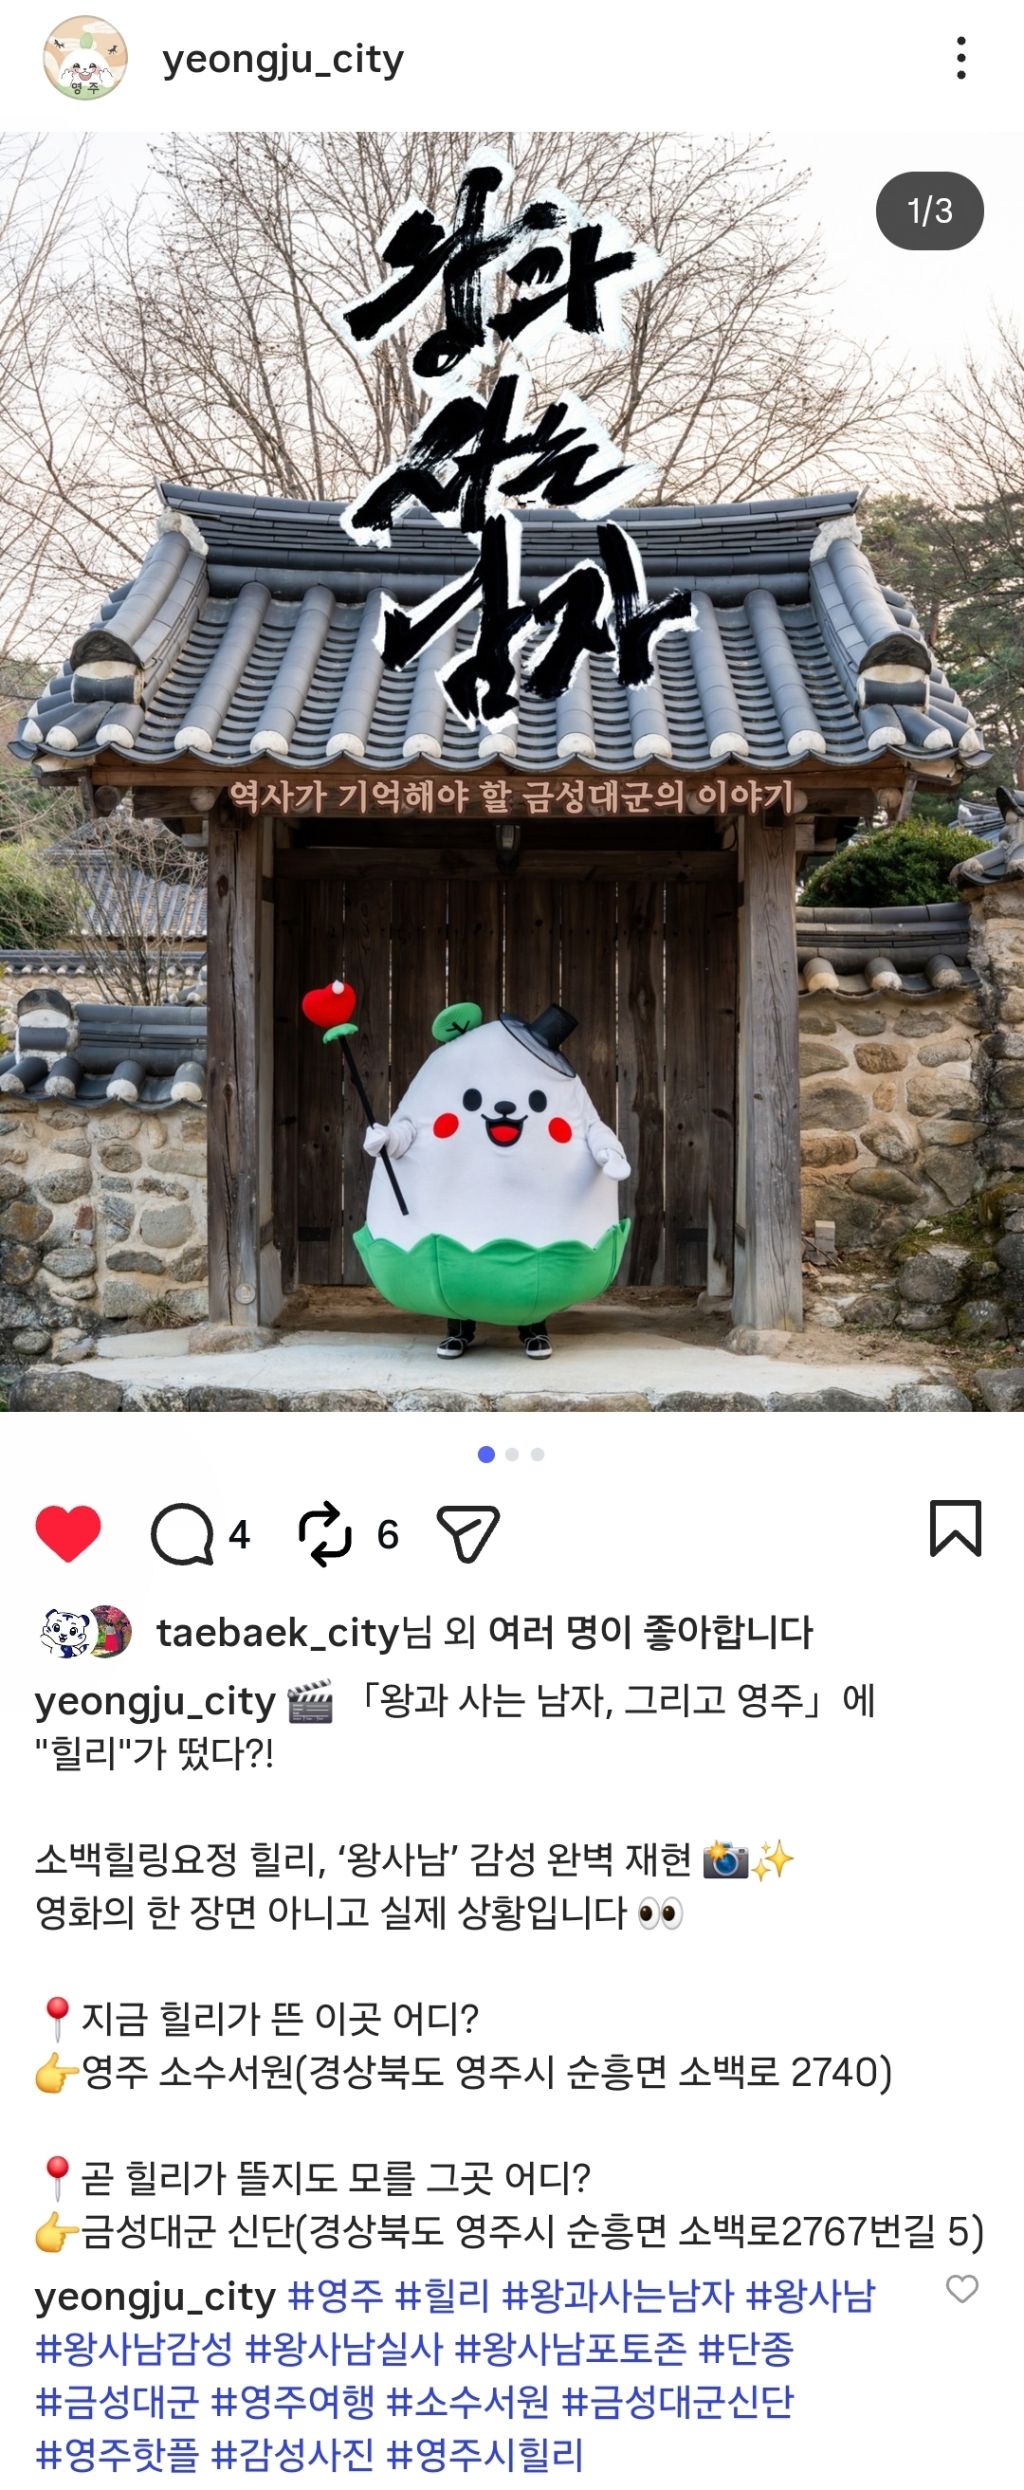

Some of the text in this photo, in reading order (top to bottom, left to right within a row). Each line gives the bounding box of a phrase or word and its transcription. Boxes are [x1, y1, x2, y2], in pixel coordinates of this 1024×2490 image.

[163, 43, 404, 82] yeongju_city
[908, 195, 953, 227] 1/3
[229, 1520, 250, 1549] 4
[378, 1519, 398, 1549] 6
[156, 1615, 813, 1655] taebaek_city님 외 여러 명이 좋아합니다
[35, 1682, 873, 1724] yeongju_city 「왕과 사는 남자, 그리고 영주」 에
[36, 1737, 272, 1771] "힐리"가 떴다?!
[35, 1843, 235, 1877] 소백힐링요정
[251, 1843, 325, 1879] 힐리,
[471, 1843, 534, 1877] 감성
[548, 1843, 611, 1877] 완벽
[626, 1843, 690, 1877] 재현
[37, 1896, 627, 1931] 영화의 한 장면 아니고 실제 상황입니다
[83, 2002, 478, 2036] 지금 힐리가 뜬 이곳 어디?
[83, 2054, 891, 2095] 영주 소수서원(경상북도 영주시 순흥면 소백로 2740)
[82, 2161, 590, 2196] 곧 힐리가 뜰지도 모를 그곳 어디?
[82, 2214, 983, 2254] 금성대군 신단(경상북도 영주시 순흥면 소백로2767번길 5)
[35, 2279, 875, 2320] yeongju_city #영주 #힐리 #왕과사는남자 #왕사남
[36, 2332, 793, 2367] #왕사남감성 #왕사남실사 #왕사남포토존 #단종
[36, 2385, 794, 2420] #금성대군 #영주여행 #소수서원 #금성대군신단
[36, 2438, 581, 2473] #영주핫플 #감성사진 #영주시힐리
